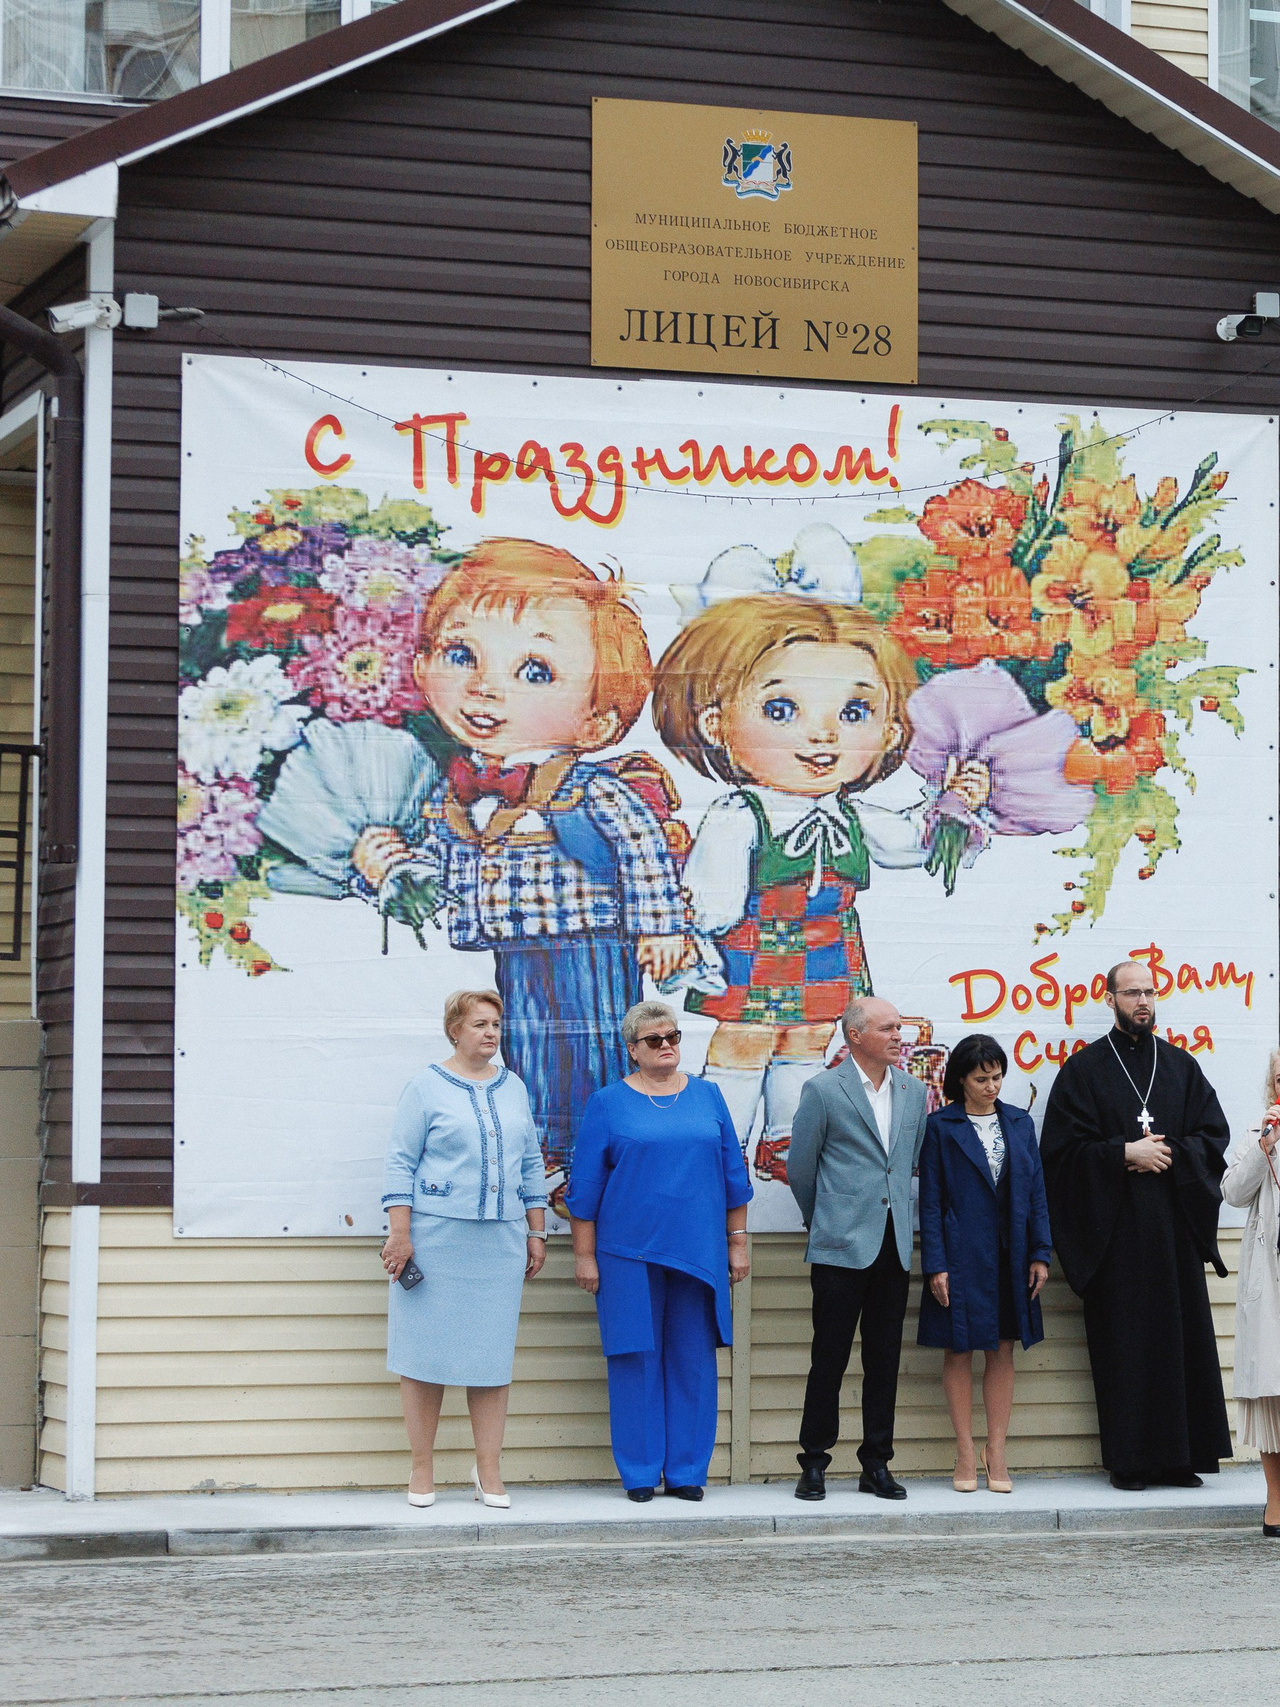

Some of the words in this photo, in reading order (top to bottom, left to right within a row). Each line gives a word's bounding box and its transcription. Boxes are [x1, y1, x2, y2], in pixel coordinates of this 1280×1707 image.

[635, 212, 771, 233] МУНИЦИПАЛЬНОЕ
[784, 223, 878, 240] БЮДЖЕТНОЕ
[605, 239, 792, 262] ОБЩЕОБРАЗОВАТЕЛЬНОЕ
[805, 251, 906, 269] УЧРЕЖДЕНИЕ
[663, 269, 721, 285] ГОРОДА
[734, 274, 851, 293] НОВОСИБИРСКА
[619, 308, 780, 353] ЛИЦЕЙ
[393, 403, 902, 526] Праздником!
[949, 952, 1108, 1026] Добра
